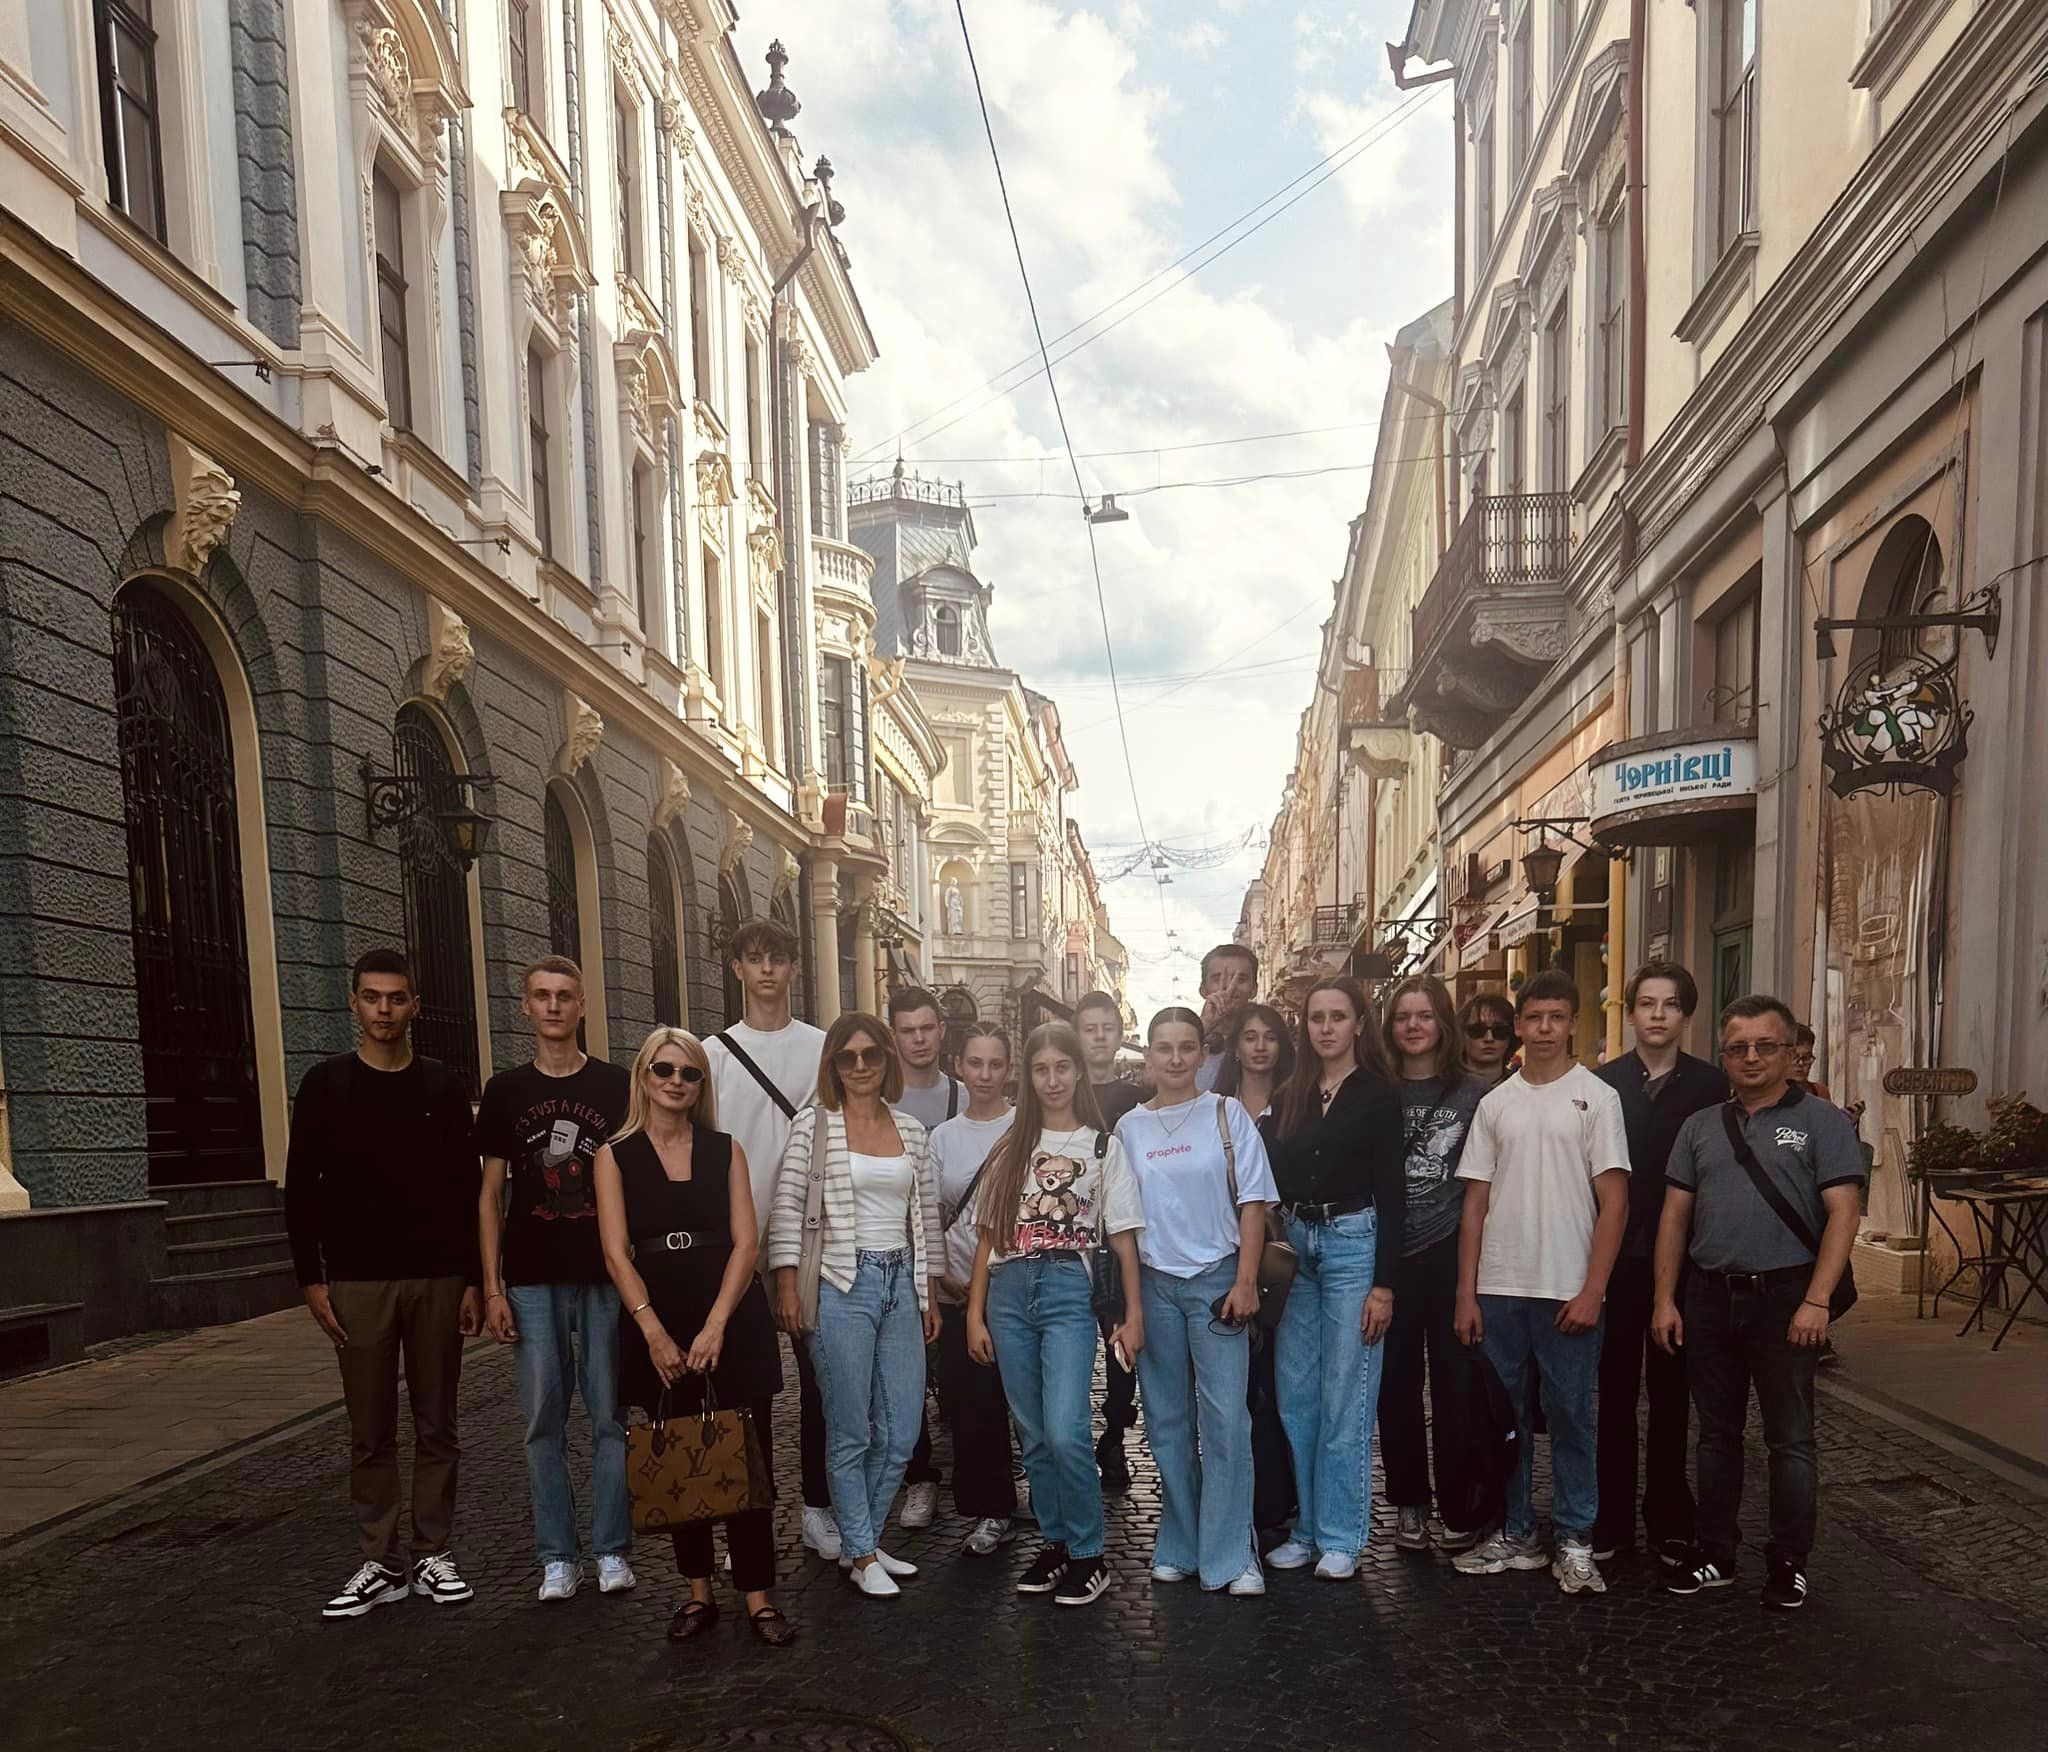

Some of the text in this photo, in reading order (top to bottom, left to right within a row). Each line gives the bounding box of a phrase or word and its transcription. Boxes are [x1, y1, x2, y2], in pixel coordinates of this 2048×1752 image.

[527, 1099, 558, 1121] JUST
[560, 1099, 570, 1113] A
[1433, 1109, 1458, 1121] OUTH
[1146, 1144, 1192, 1161] graphite
[666, 1231, 693, 1250] CD
